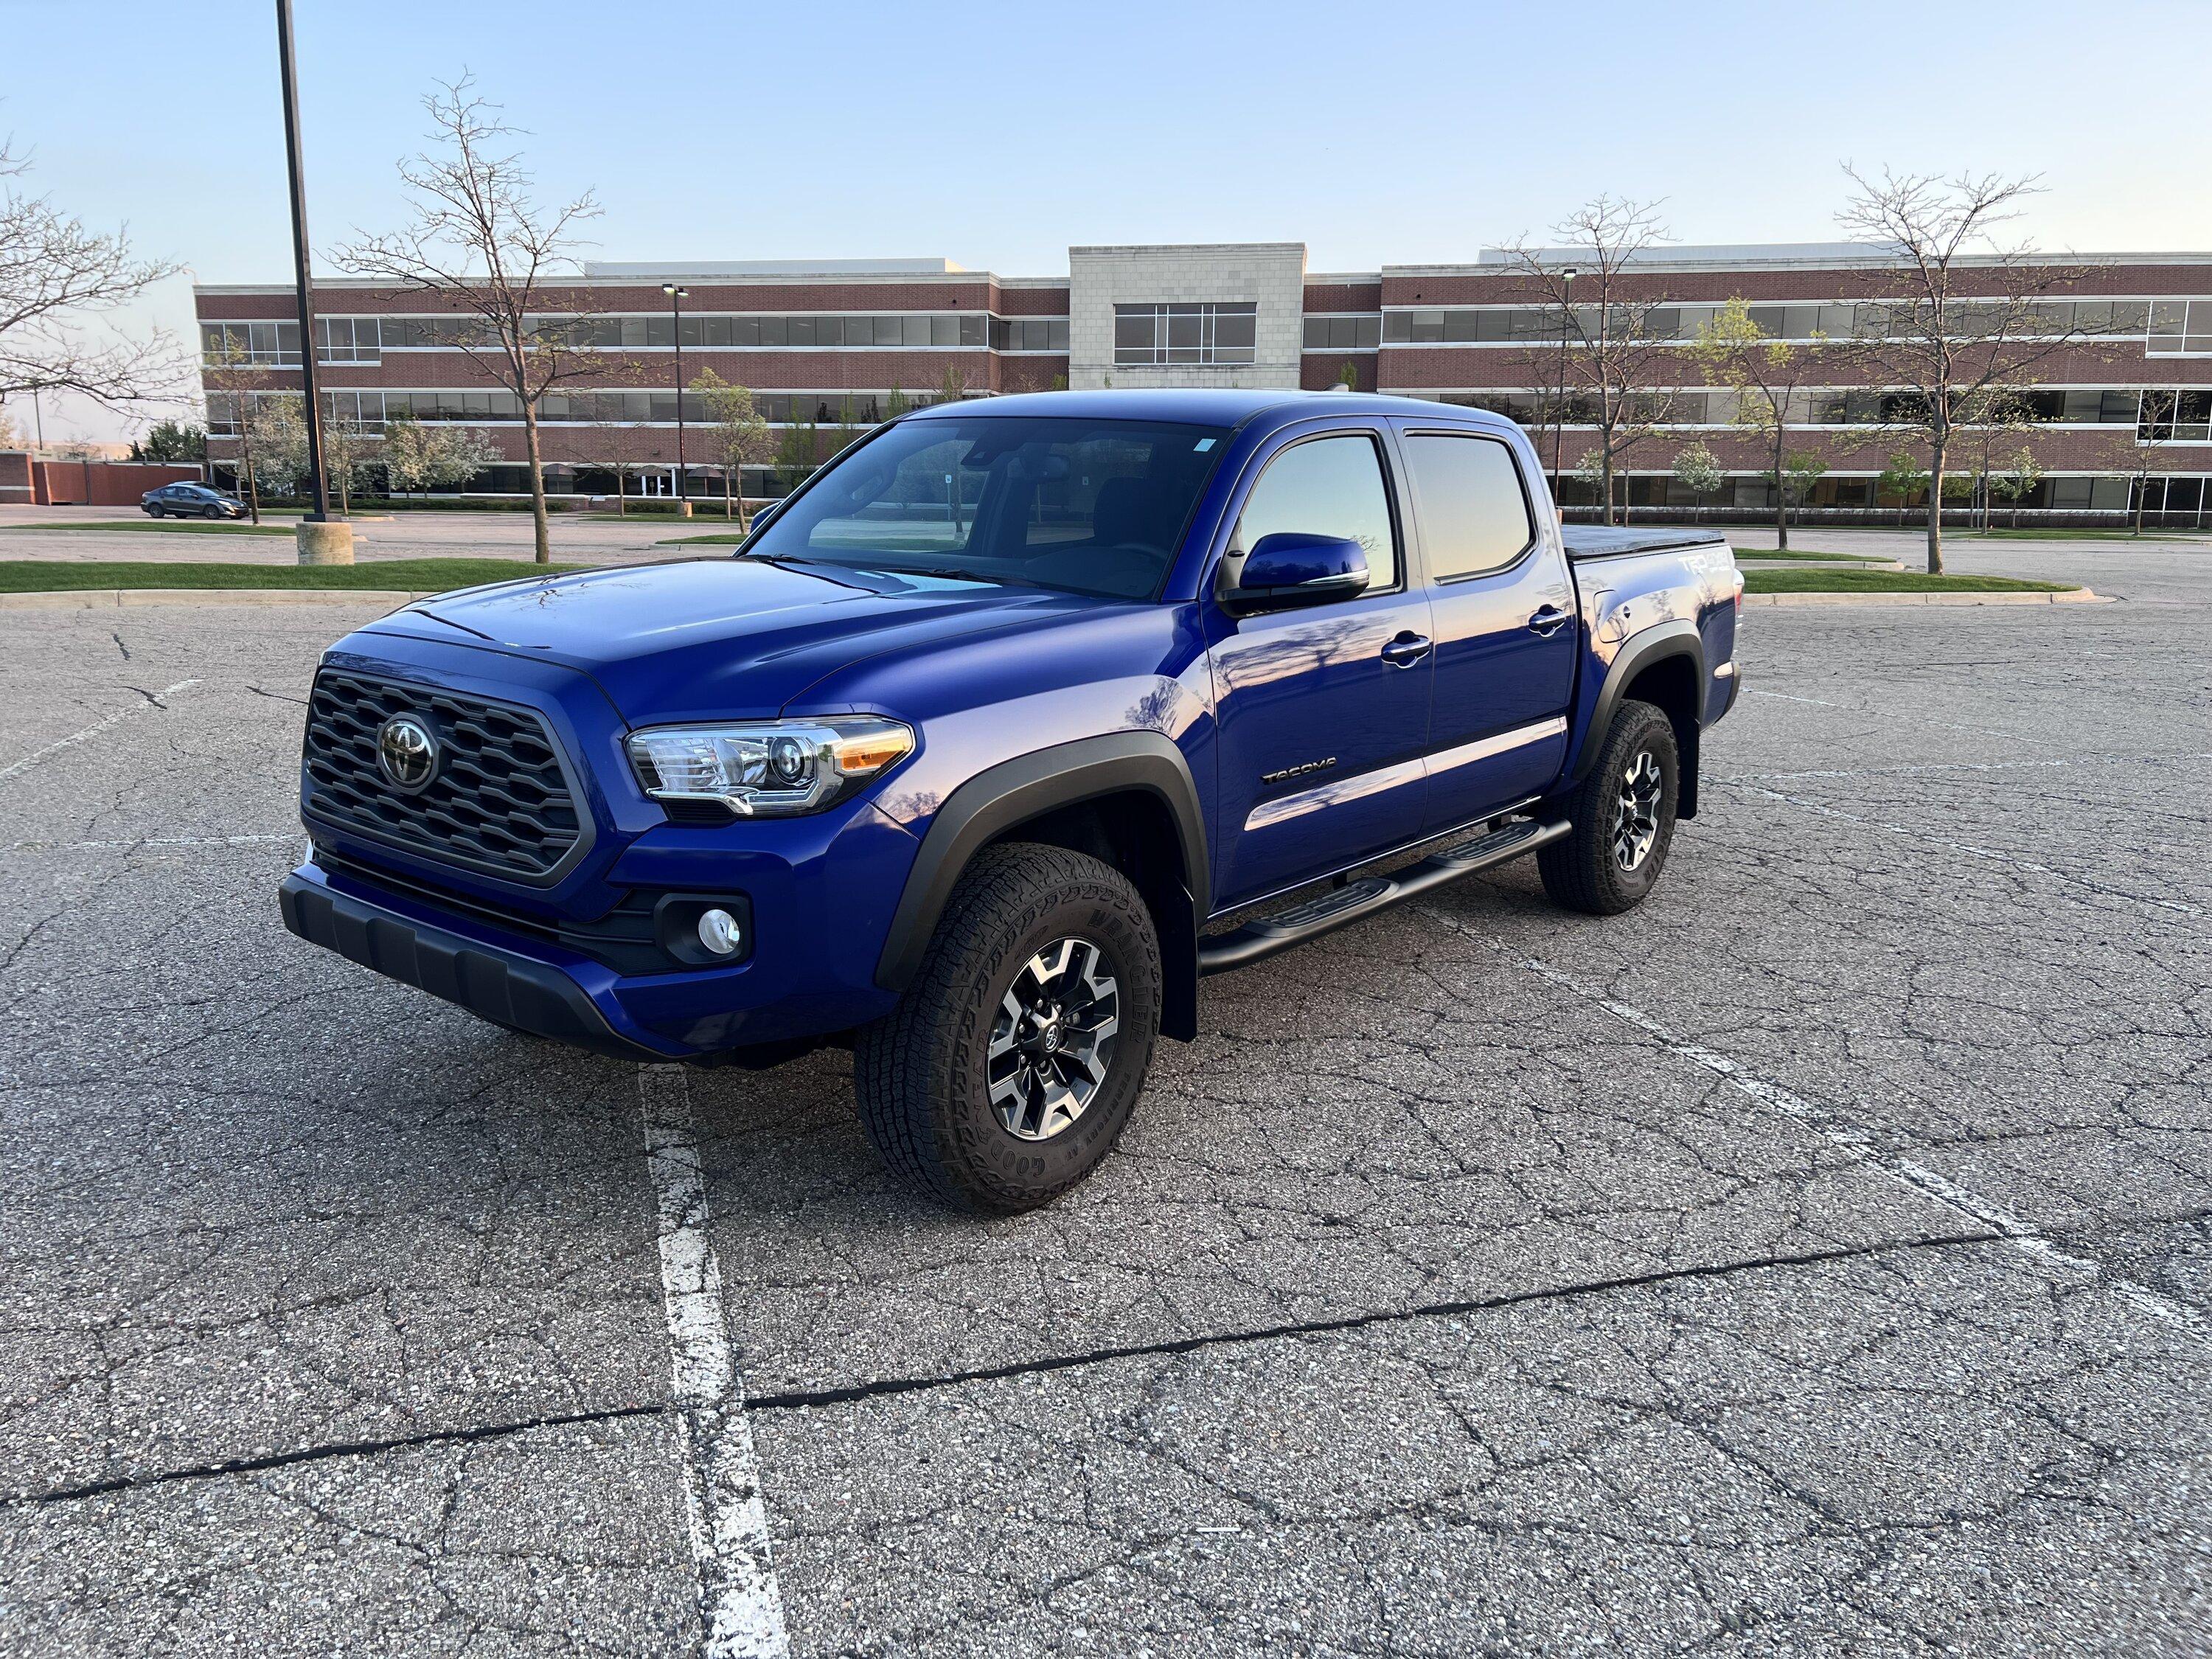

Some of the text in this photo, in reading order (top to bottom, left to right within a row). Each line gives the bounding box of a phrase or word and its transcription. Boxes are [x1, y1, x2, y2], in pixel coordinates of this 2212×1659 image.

[1260, 757, 1337, 785] TACOMA
[1087, 908, 1150, 1043] WRANGLER
[972, 1028, 1046, 1178] GOODYEAR
[1084, 1071, 1132, 1147] TERRITORY
